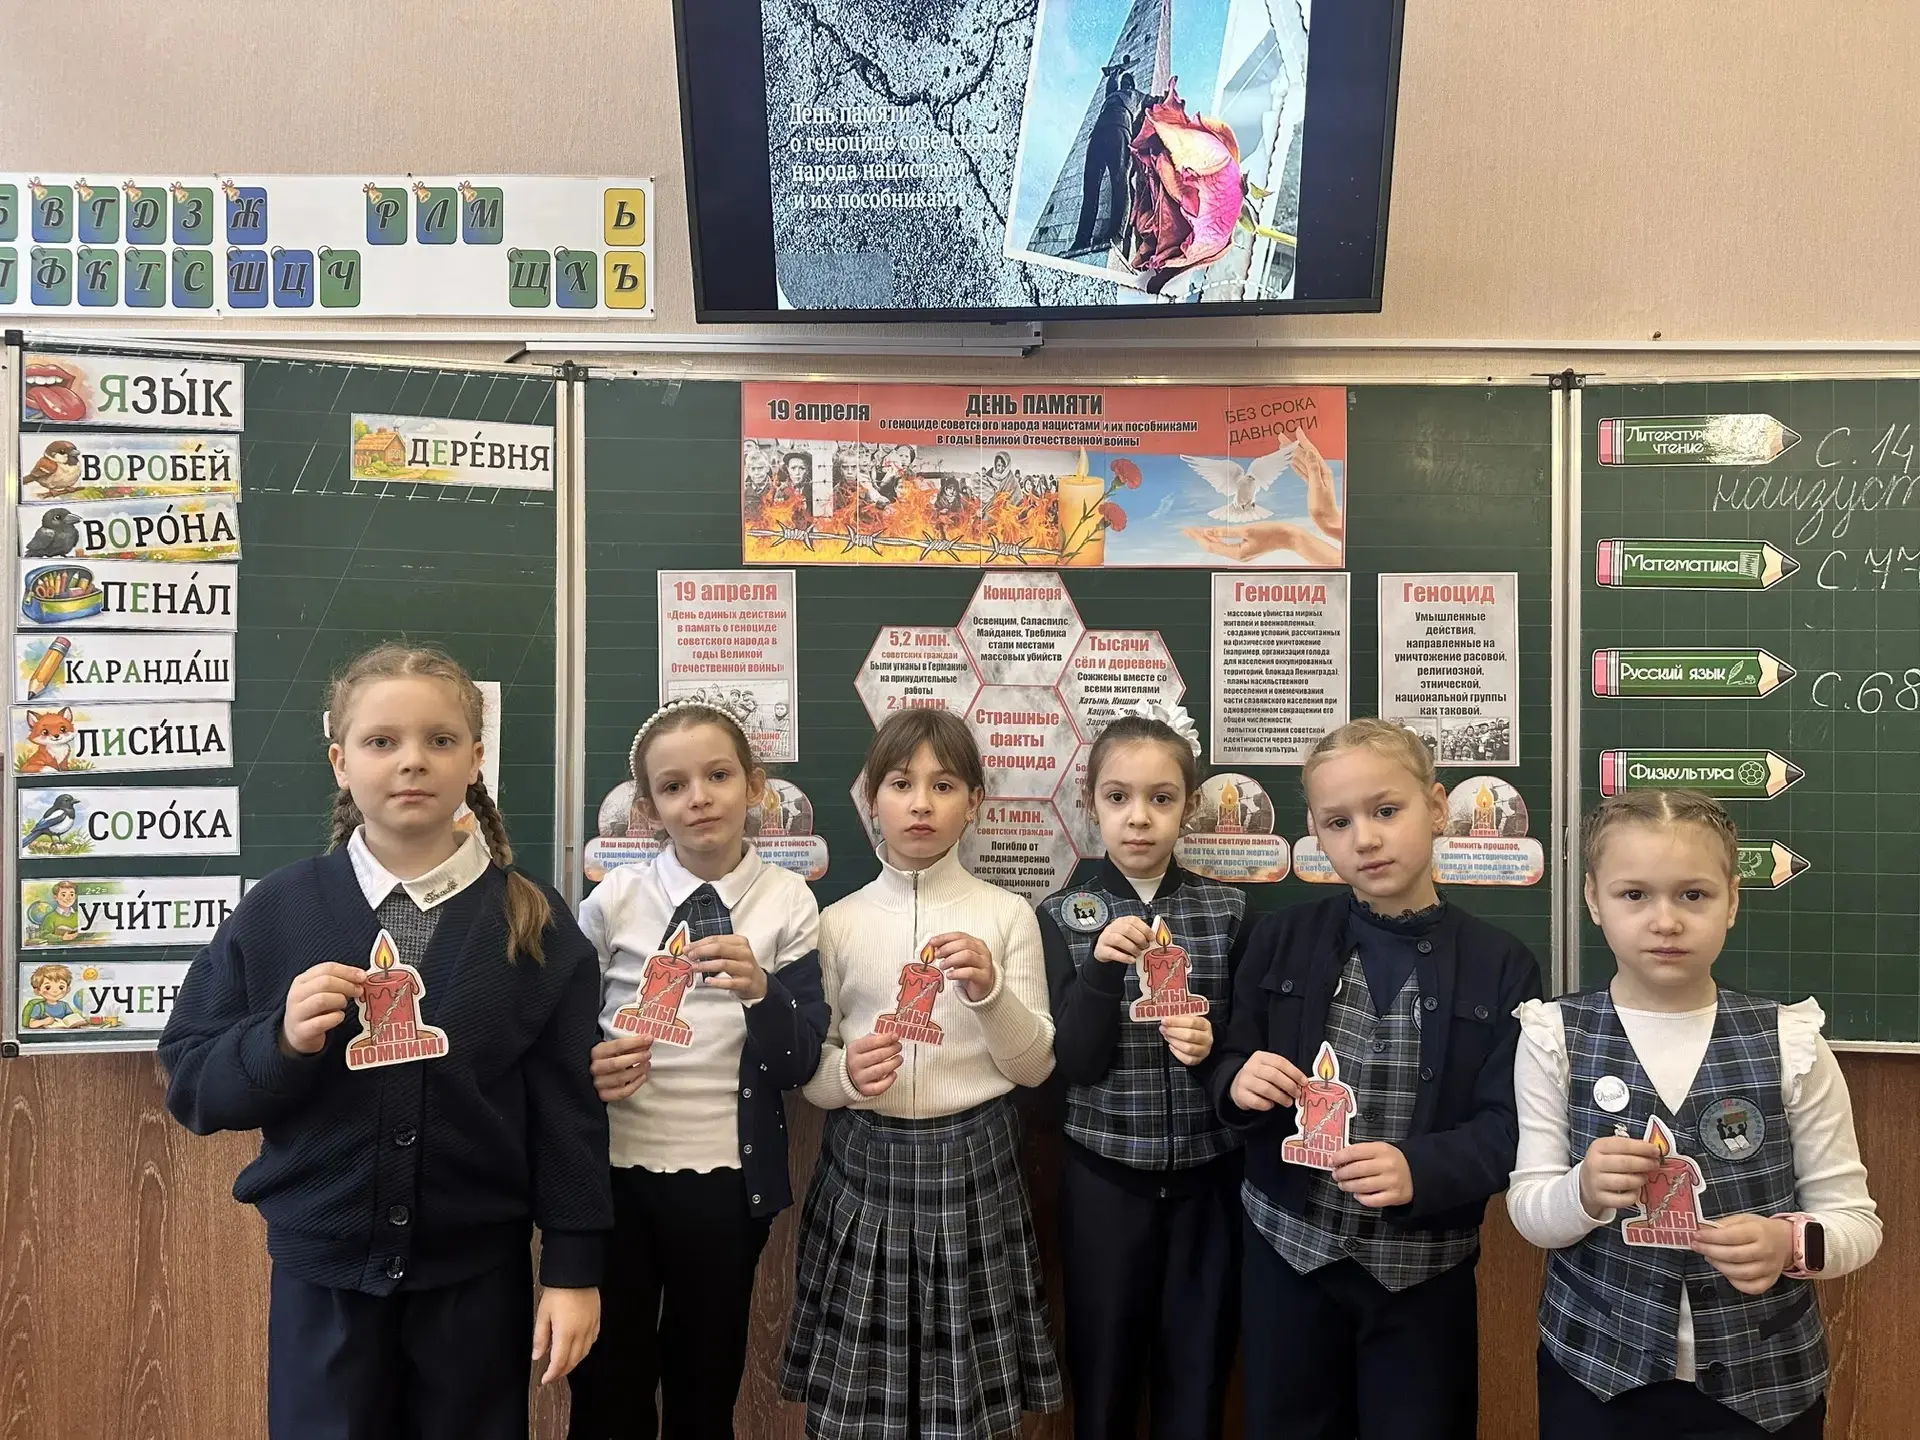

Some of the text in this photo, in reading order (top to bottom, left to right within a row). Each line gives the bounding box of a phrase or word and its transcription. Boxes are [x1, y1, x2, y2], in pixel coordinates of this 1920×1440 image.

[40, 197, 65, 228] В
[182, 199, 203, 229] З
[230, 198, 265, 229] Ж
[375, 199, 400, 229] Р
[425, 198, 450, 232] Л
[469, 198, 499, 228] М
[612, 201, 636, 229] Ь
[36, 257, 67, 289] Ф
[85, 260, 113, 291] К
[135, 262, 161, 291] Т
[183, 261, 206, 292] С
[229, 261, 266, 293] Ш
[279, 262, 310, 298] Ц
[327, 260, 356, 291] Ч
[511, 262, 550, 295] Щ
[564, 261, 589, 292] Х
[613, 263, 639, 292] Ъ
[767, 399, 871, 423] 19 апреля
[965, 394, 1103, 418] ДЕНЬ ПАМЯТИ
[1225, 405, 1256, 424] БЕЗ
[1260, 396, 1317, 419] СРОКА
[888, 420, 939, 431] геноциде
[1001, 420, 1040, 431] народа
[1042, 420, 1100, 431] нацистами
[1111, 422, 1123, 432] их
[1125, 420, 1198, 432] пособниками
[1229, 415, 1319, 446] ДАВНОСТИ
[946, 434, 1140, 447] годы Великой Отечественной войны
[1652, 443, 1704, 454] чтение
[1624, 553, 1739, 573] Математика
[673, 581, 778, 602] 19 апреля
[983, 585, 1062, 602] Концлагеря
[1235, 582, 1326, 604] Геноцид
[1403, 582, 1495, 605] Геноцид
[1415, 611, 1486, 622] Умышленные
[685, 623, 778, 634] память геноциде
[677, 636, 771, 647] советского народа
[889, 630, 950, 648] 5,2 млн.
[988, 641, 1055, 650] стали местами
[1089, 636, 1150, 652] Тысячи
[1406, 638, 1495, 649] направленные на
[692, 648, 763, 660] годы Великой
[980, 651, 1062, 662] массовых убийств
[1394, 652, 1462, 663] уничтожение
[671, 661, 746, 673] Отечественной
[870, 660, 968, 672] Были угнаны Германию
[1075, 655, 1166, 671] сёл деревень
[1077, 672, 1168, 682] Сожжены вместе со
[1620, 663, 1726, 681] Русский язык
[880, 675, 958, 684] на принудительные
[904, 686, 933, 696] работы
[1084, 685, 1160, 694] всеми жителями
[1395, 691, 1507, 704] национальной группы
[975, 708, 1060, 726] Страшные
[1420, 706, 1438, 715] как
[990, 732, 1045, 748] факты
[981, 754, 1056, 771] геноцида
[1628, 762, 1735, 781] Физкультура
[986, 808, 1045, 824] 4,1 млн.
[991, 840, 1039, 852] Погибло от
[979, 854, 1050, 865] преднамеренно
[974, 865, 1055, 876] жестоких условий
[88, 985, 180, 1015] УЧЕН
[1626, 1227, 1695, 1246] ПОМН
